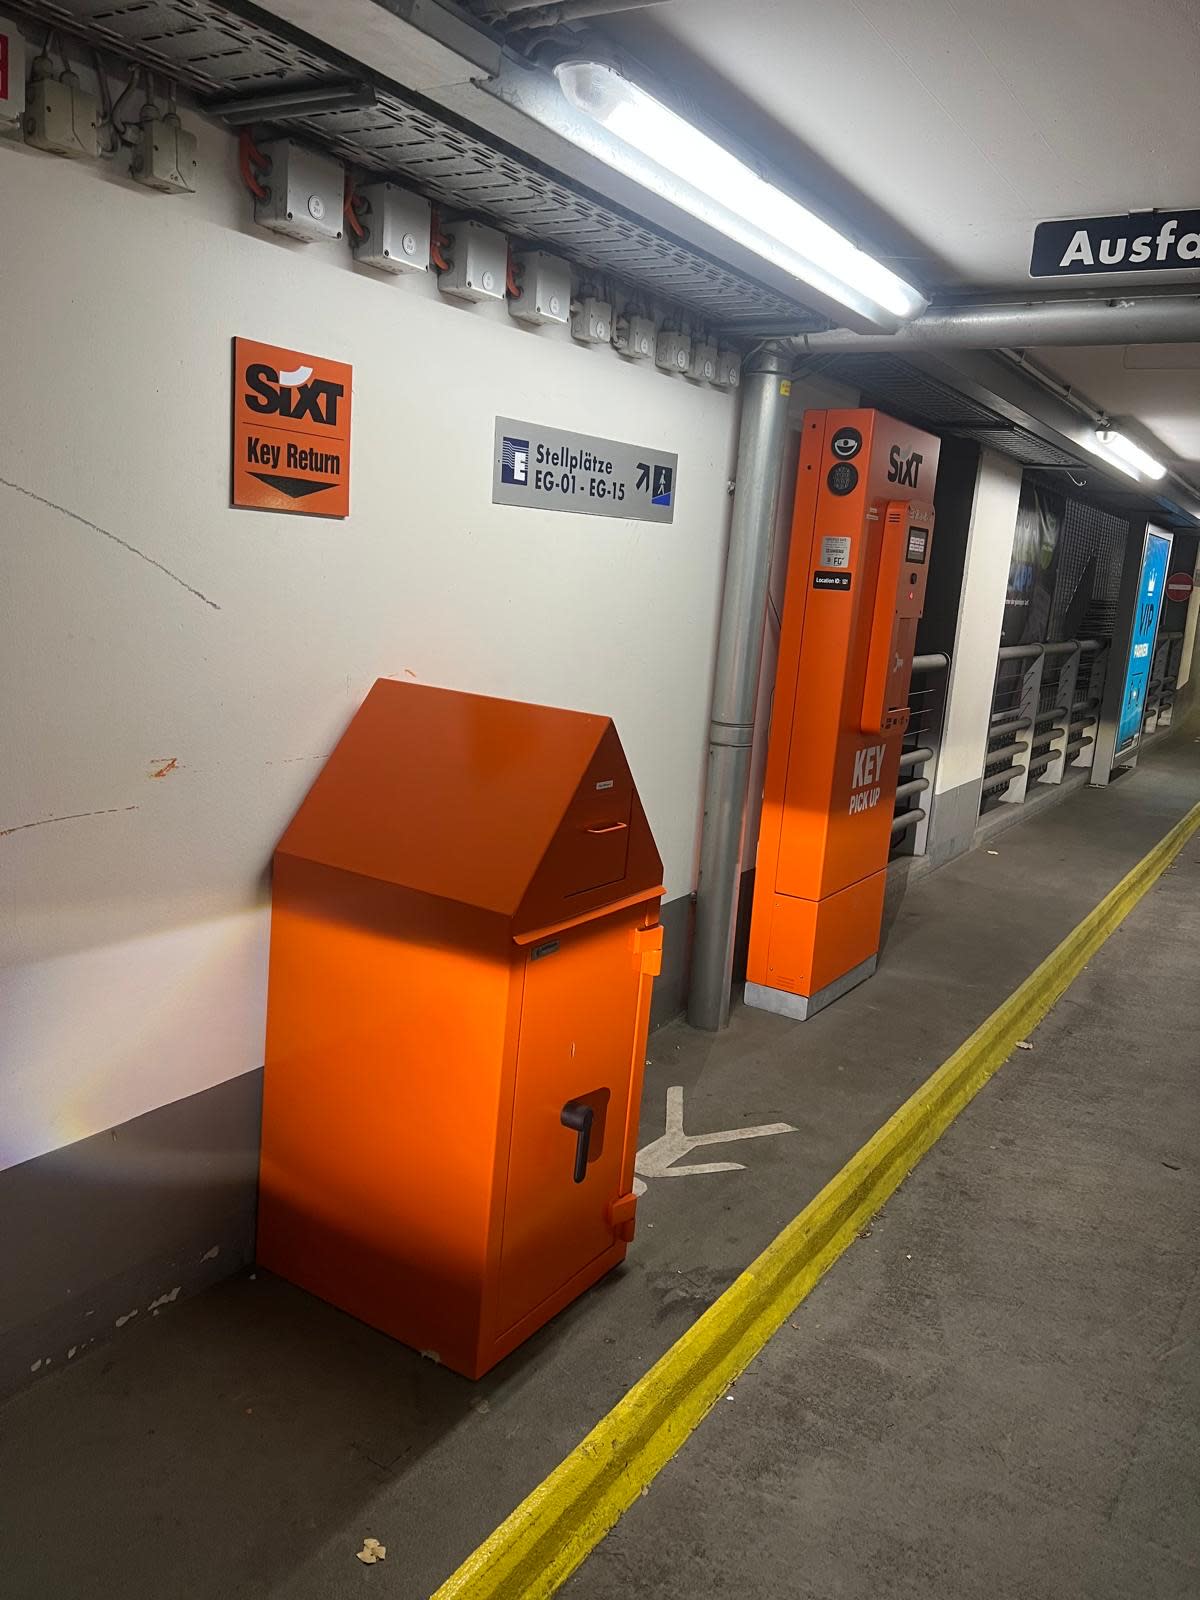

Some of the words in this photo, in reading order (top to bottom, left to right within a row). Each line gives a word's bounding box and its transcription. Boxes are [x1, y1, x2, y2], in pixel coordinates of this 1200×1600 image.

[247, 436, 281, 469] Key
[287, 443, 340, 475] Return
[535, 443, 613, 475] Stellplätze
[535, 470, 576, 494] EG-01
[589, 478, 625, 500] EG-15
[1139, 603, 1154, 637] VIP
[852, 744, 886, 789] KEY
[849, 790, 869, 815] PICK
[869, 787, 880, 807] UP
